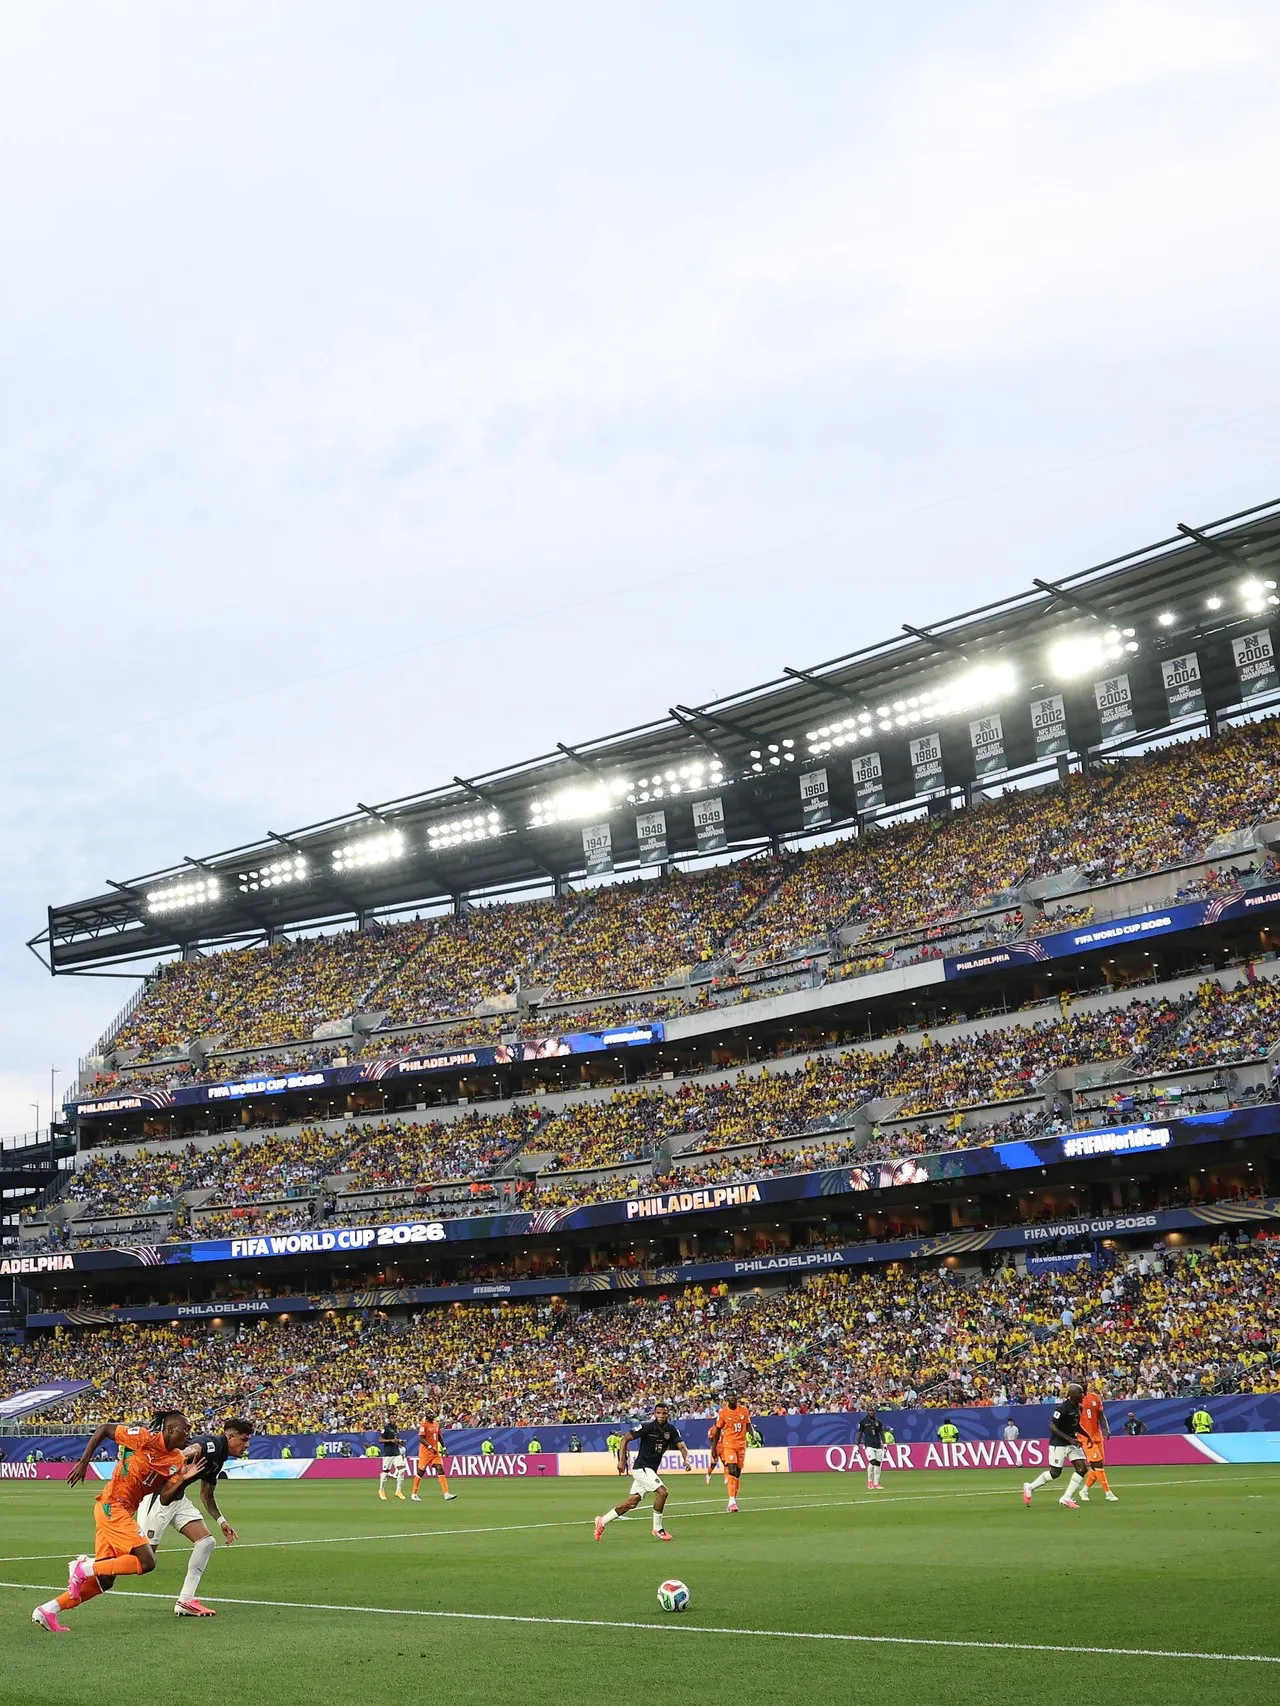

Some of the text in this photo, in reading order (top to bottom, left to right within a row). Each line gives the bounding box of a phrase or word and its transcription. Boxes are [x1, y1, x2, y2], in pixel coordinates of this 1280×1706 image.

[1238, 644, 1270, 664] 2006
[1240, 665, 1276, 682] CHAMPIONS
[1242, 659, 1270, 674] NFC EAST
[1167, 668, 1197, 687] 2004
[1100, 688, 1128, 707] 2003
[1169, 688, 1202, 704] CHAMPIONS
[1178, 685, 1190, 694] NFC
[1035, 709, 1062, 726] 2002
[1101, 709, 1133, 724] CHAMPIONS
[1103, 704, 1128, 717] NFC EAST
[975, 728, 1000, 745] 2001
[1036, 728, 1067, 744] CHAMPIONS
[1038, 724, 1063, 736] NFC EAST
[914, 747, 938, 763] 1988
[975, 746, 1004, 762] CHAMPIONS
[977, 742, 1001, 754] NFC EAST
[856, 765, 879, 781] 1980
[915, 766, 942, 780] CHAMPIONS
[916, 761, 939, 773] NFC EAST
[804, 782, 825, 797] 1960
[857, 784, 883, 797] CHAMPIONS
[803, 800, 829, 813] CHAMPIONS
[697, 810, 720, 824] 1949
[641, 824, 663, 837] 1948
[697, 828, 724, 840] CHAMPIONS
[586, 835, 608, 849] 1947
[1245, 892, 1280, 907] PHILAD
[1074, 917, 1172, 945] FIFA WORLD CUP 2026
[956, 953, 1010, 971] PHILADELPHIA
[399, 1053, 476, 1073] PHILADELPHIA
[208, 1073, 325, 1099] FIFA WORLD CUP 2026
[77, 1098, 142, 1115] PHILADELPHIA
[1063, 1127, 1171, 1157] #FIFAWorldCup
[626, 1183, 761, 1219] PHILADELPHIA
[1024, 1215, 1157, 1240] FIFA WORLD CUP 2026
[230, 1222, 446, 1257] FIFA WORLD CUP 2026
[0, 1254, 73, 1275] ADELPHIA
[734, 1251, 844, 1273] PHILADELPHIA
[473, 1284, 511, 1294] #FIFAWorldCup
[178, 1302, 269, 1315] PHILADELPHIA
[733, 1423, 742, 1433] 19
[324, 1441, 343, 1453] FIFA
[825, 1439, 1043, 1472] QAAR AIRWAYS
[449, 1454, 527, 1477] AIRWAYS
[141, 1469, 159, 1487] 11
